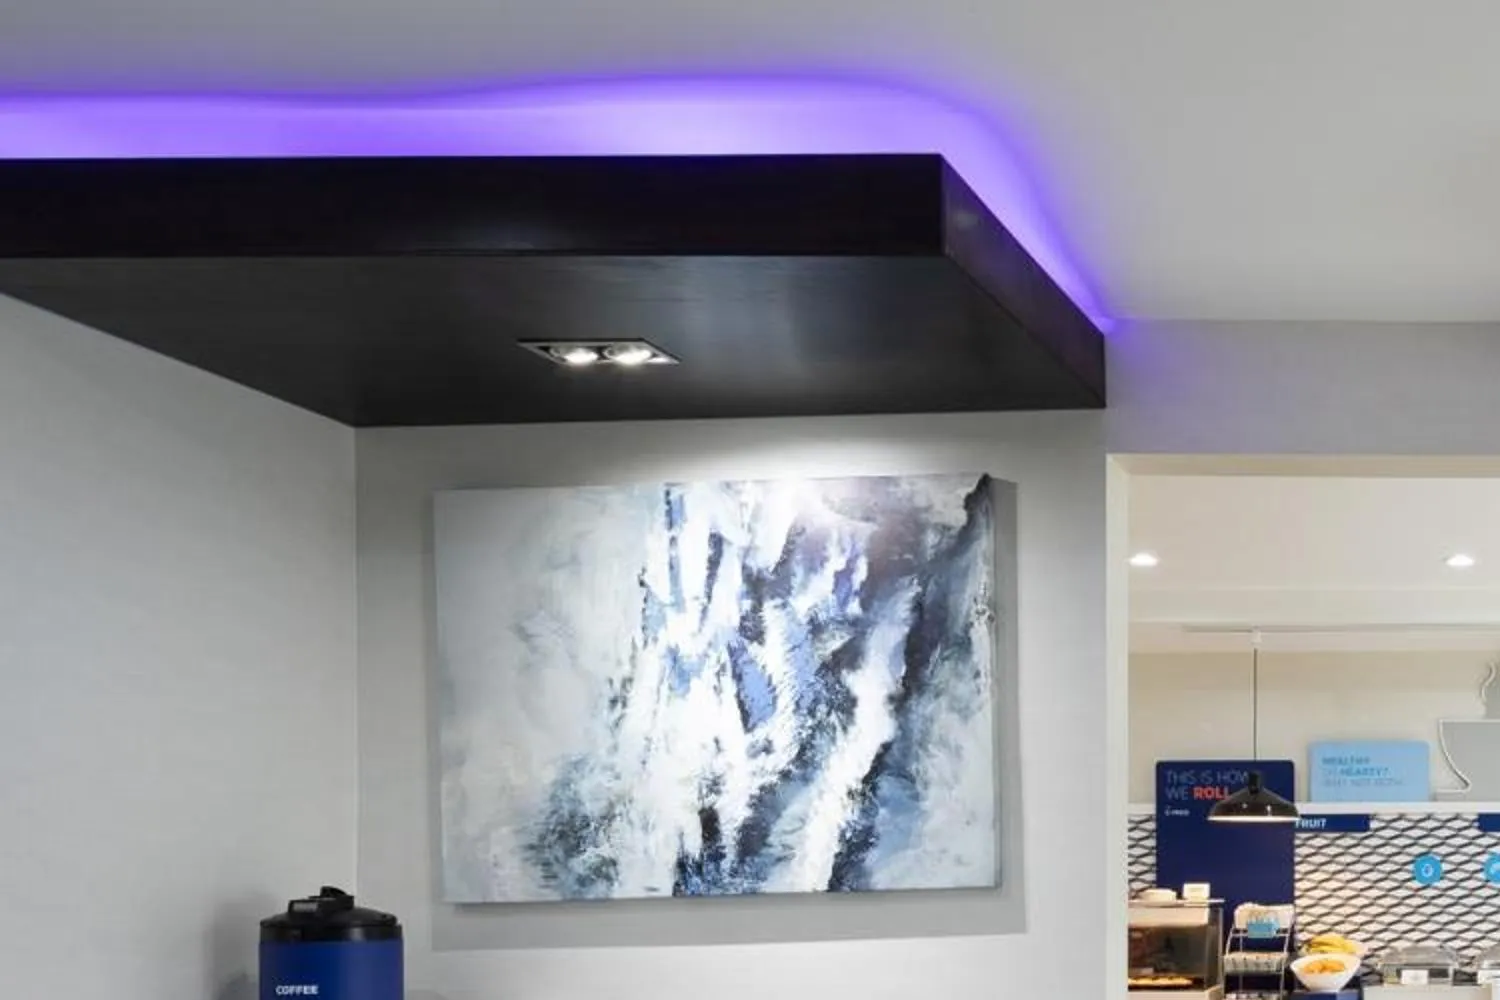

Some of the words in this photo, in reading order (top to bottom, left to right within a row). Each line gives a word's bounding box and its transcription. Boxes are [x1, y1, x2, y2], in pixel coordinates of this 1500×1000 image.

[1165, 769, 1196, 785] THIS
[1200, 769, 1213, 785] IS
[1165, 786, 1189, 800] WE
[1193, 786, 1231, 800] ROLL
[1295, 818, 1327, 829] FRUIT
[275, 984, 319, 996] COFFEE
